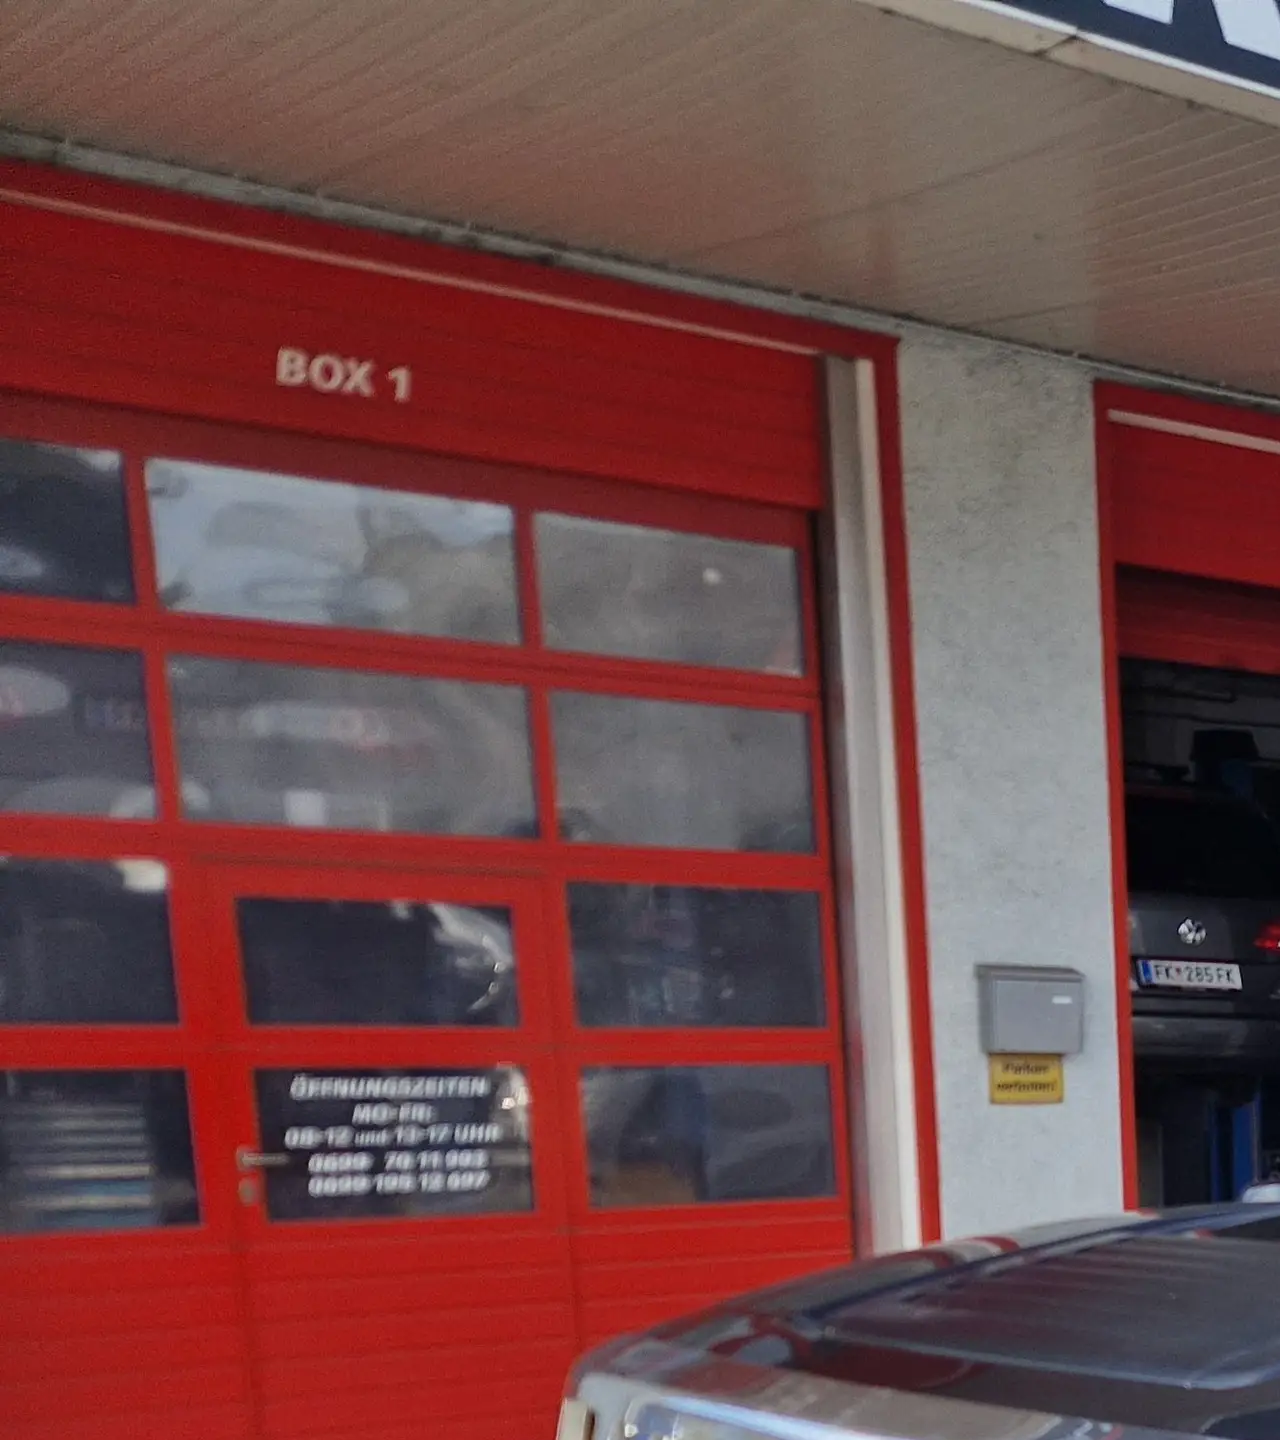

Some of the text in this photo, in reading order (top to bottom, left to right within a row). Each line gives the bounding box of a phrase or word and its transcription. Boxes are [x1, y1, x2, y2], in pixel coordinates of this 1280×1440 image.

[275, 347, 412, 403] BOX 1
[290, 1074, 489, 1101] ÖFFNUNGSZEITEN
